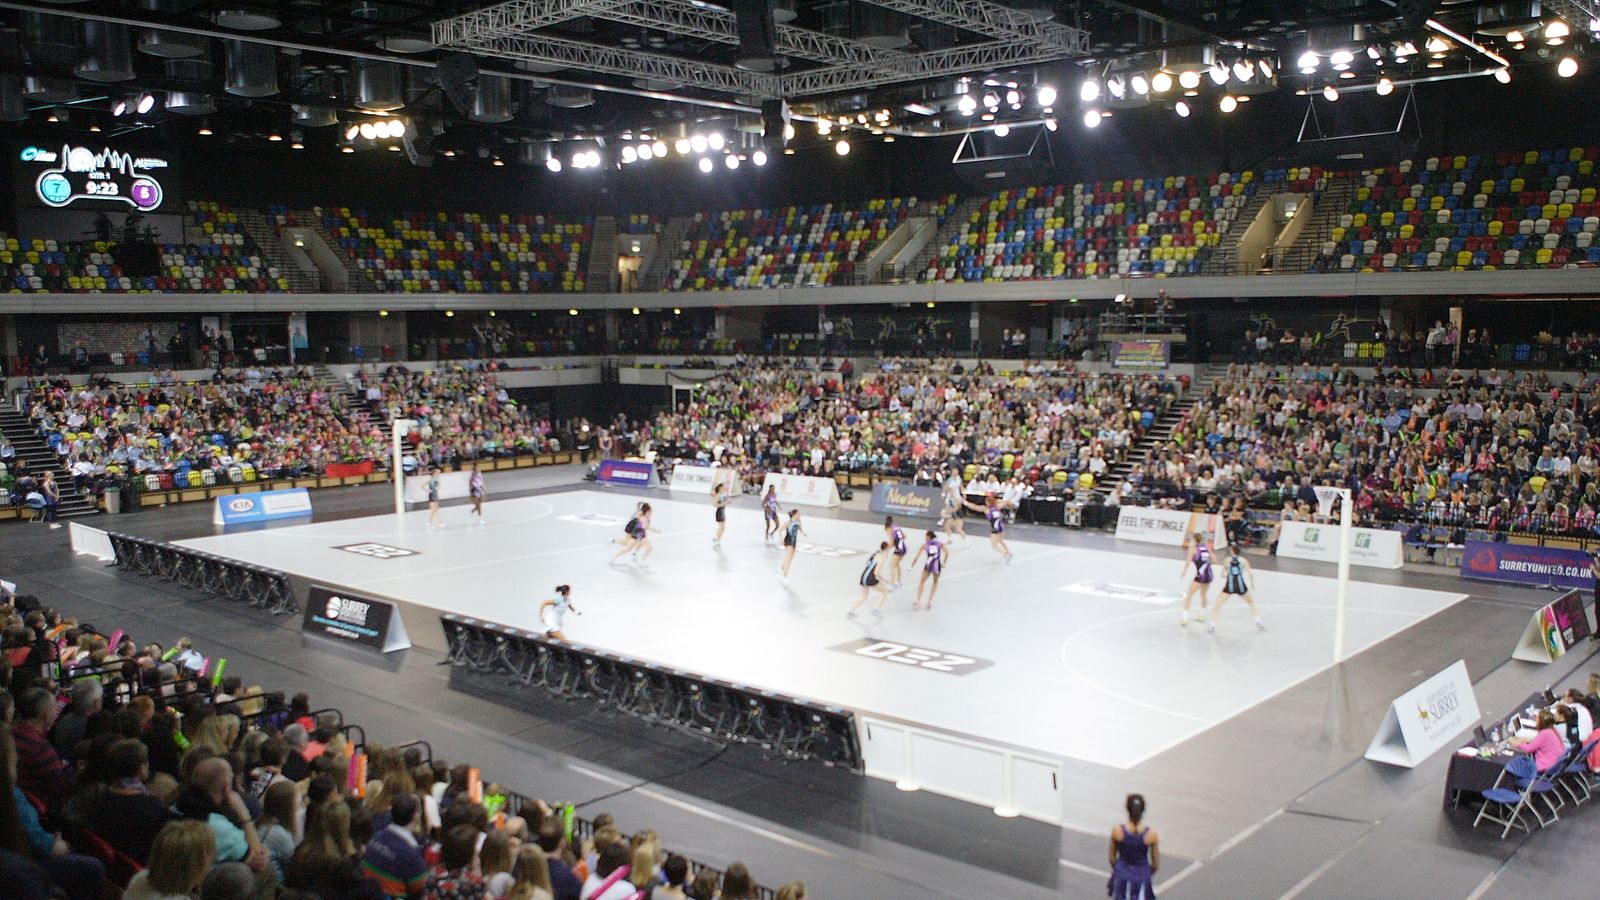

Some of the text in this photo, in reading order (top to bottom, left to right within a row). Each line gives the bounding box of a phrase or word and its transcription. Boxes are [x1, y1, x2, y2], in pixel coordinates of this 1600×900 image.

[53, 183, 61, 193] 7
[86, 181, 118, 195] 9:23
[233, 501, 252, 510] KIA
[1120, 516, 1138, 527] FEEL
[1140, 518, 1154, 529] THE
[1157, 519, 1185, 532] TINGLE
[1499, 559, 1592, 578] SURREYUNITED.CO.UK
[1429, 690, 1459, 724] SURREY
